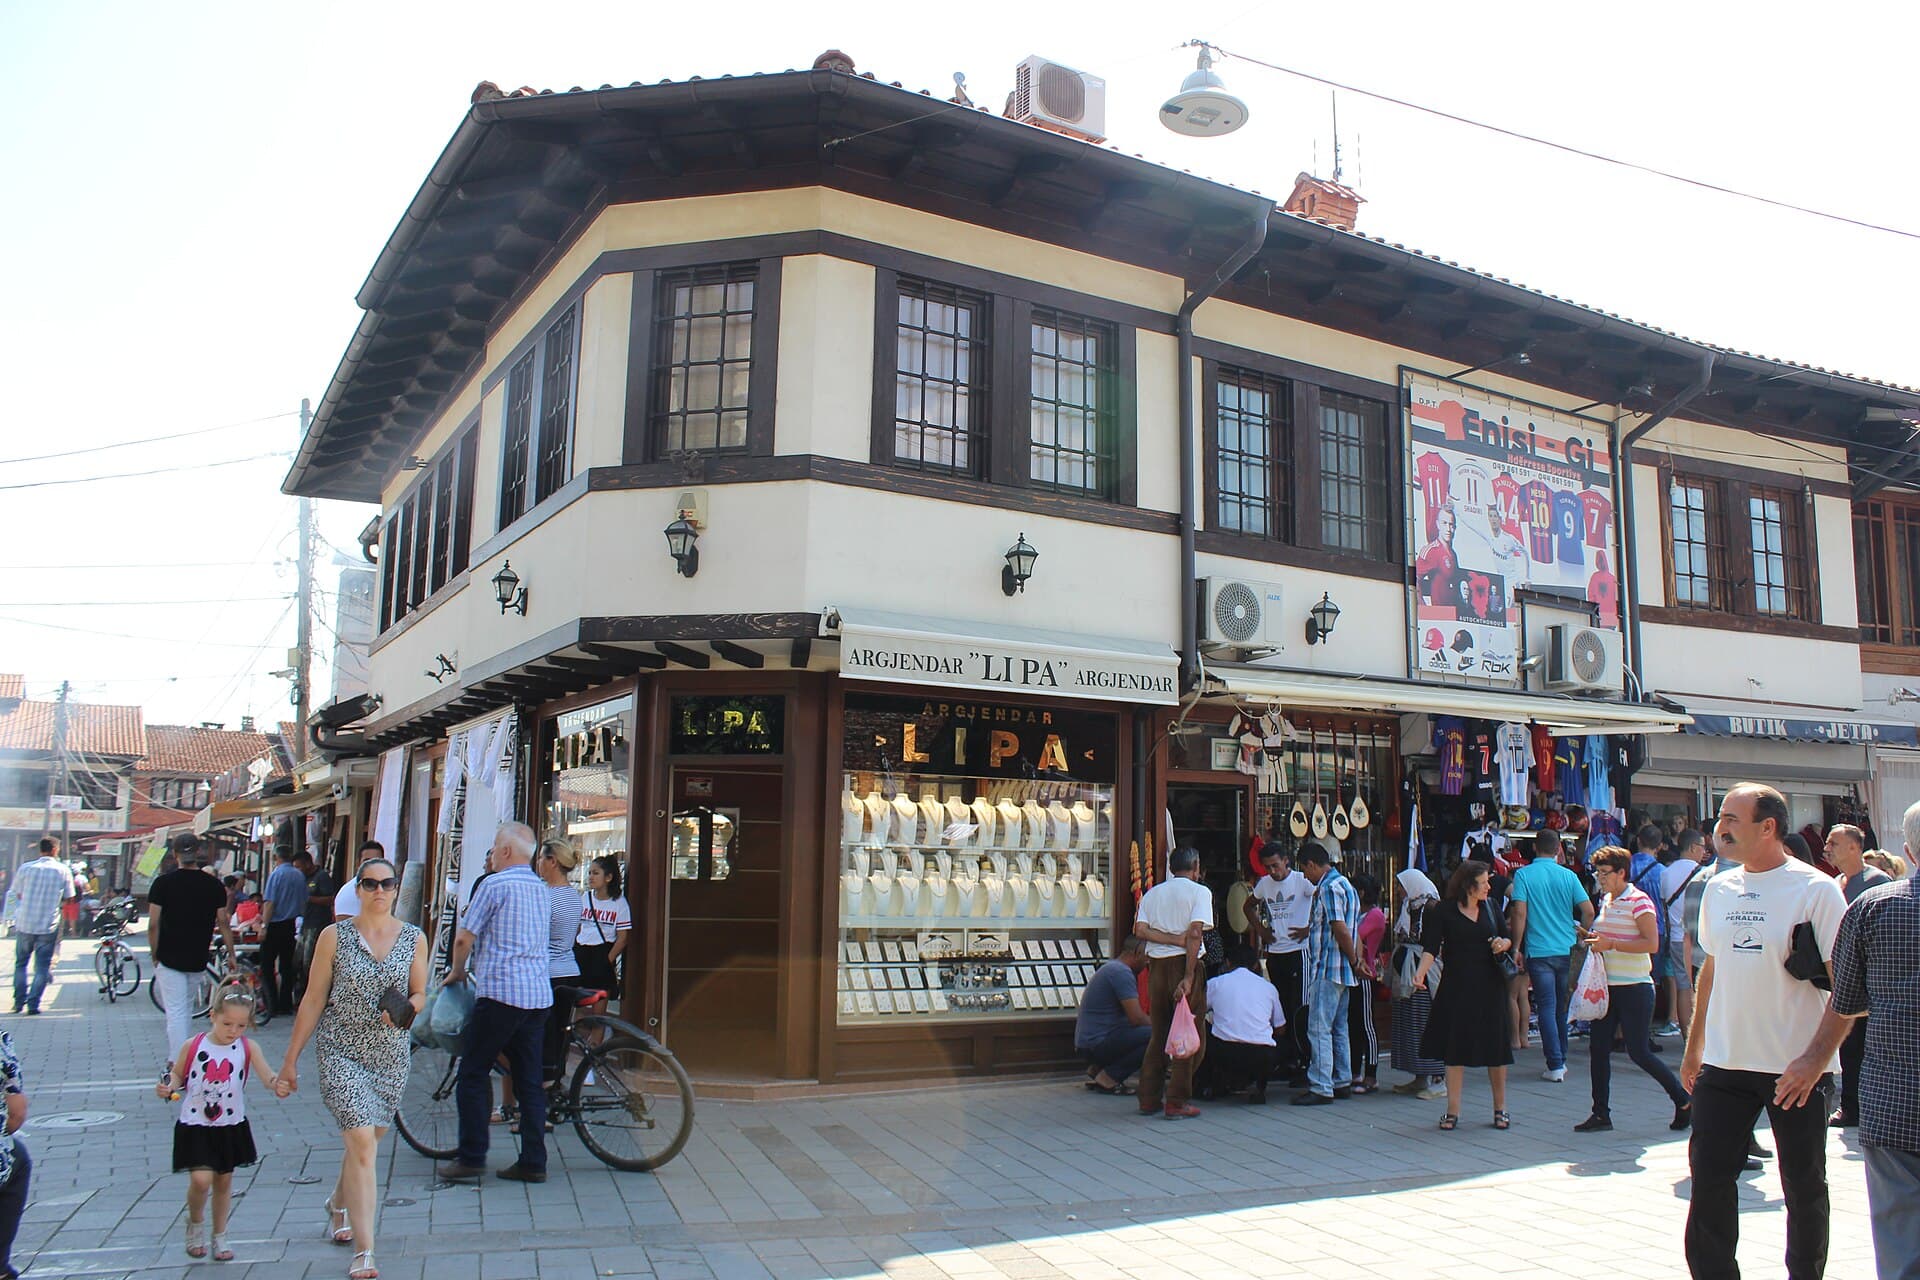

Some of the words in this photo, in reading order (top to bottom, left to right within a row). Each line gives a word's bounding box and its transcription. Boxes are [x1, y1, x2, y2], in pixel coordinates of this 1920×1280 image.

[1462, 408, 1536, 457] Enisi
[1496, 491, 1520, 528] 44
[1530, 499, 1550, 529] 10
[1590, 508, 1599, 534] 7
[1563, 511, 1575, 539] 9
[849, 648, 964, 675] ARGJENDAR
[1074, 669, 1173, 693] ARGJENDAR
[922, 702, 1053, 725] ARGJENDAR
[1729, 717, 1788, 736] BUTIK
[903, 722, 1070, 772] LIPA
[1480, 745, 1490, 775] 7
[1508, 745, 1525, 774] 10
